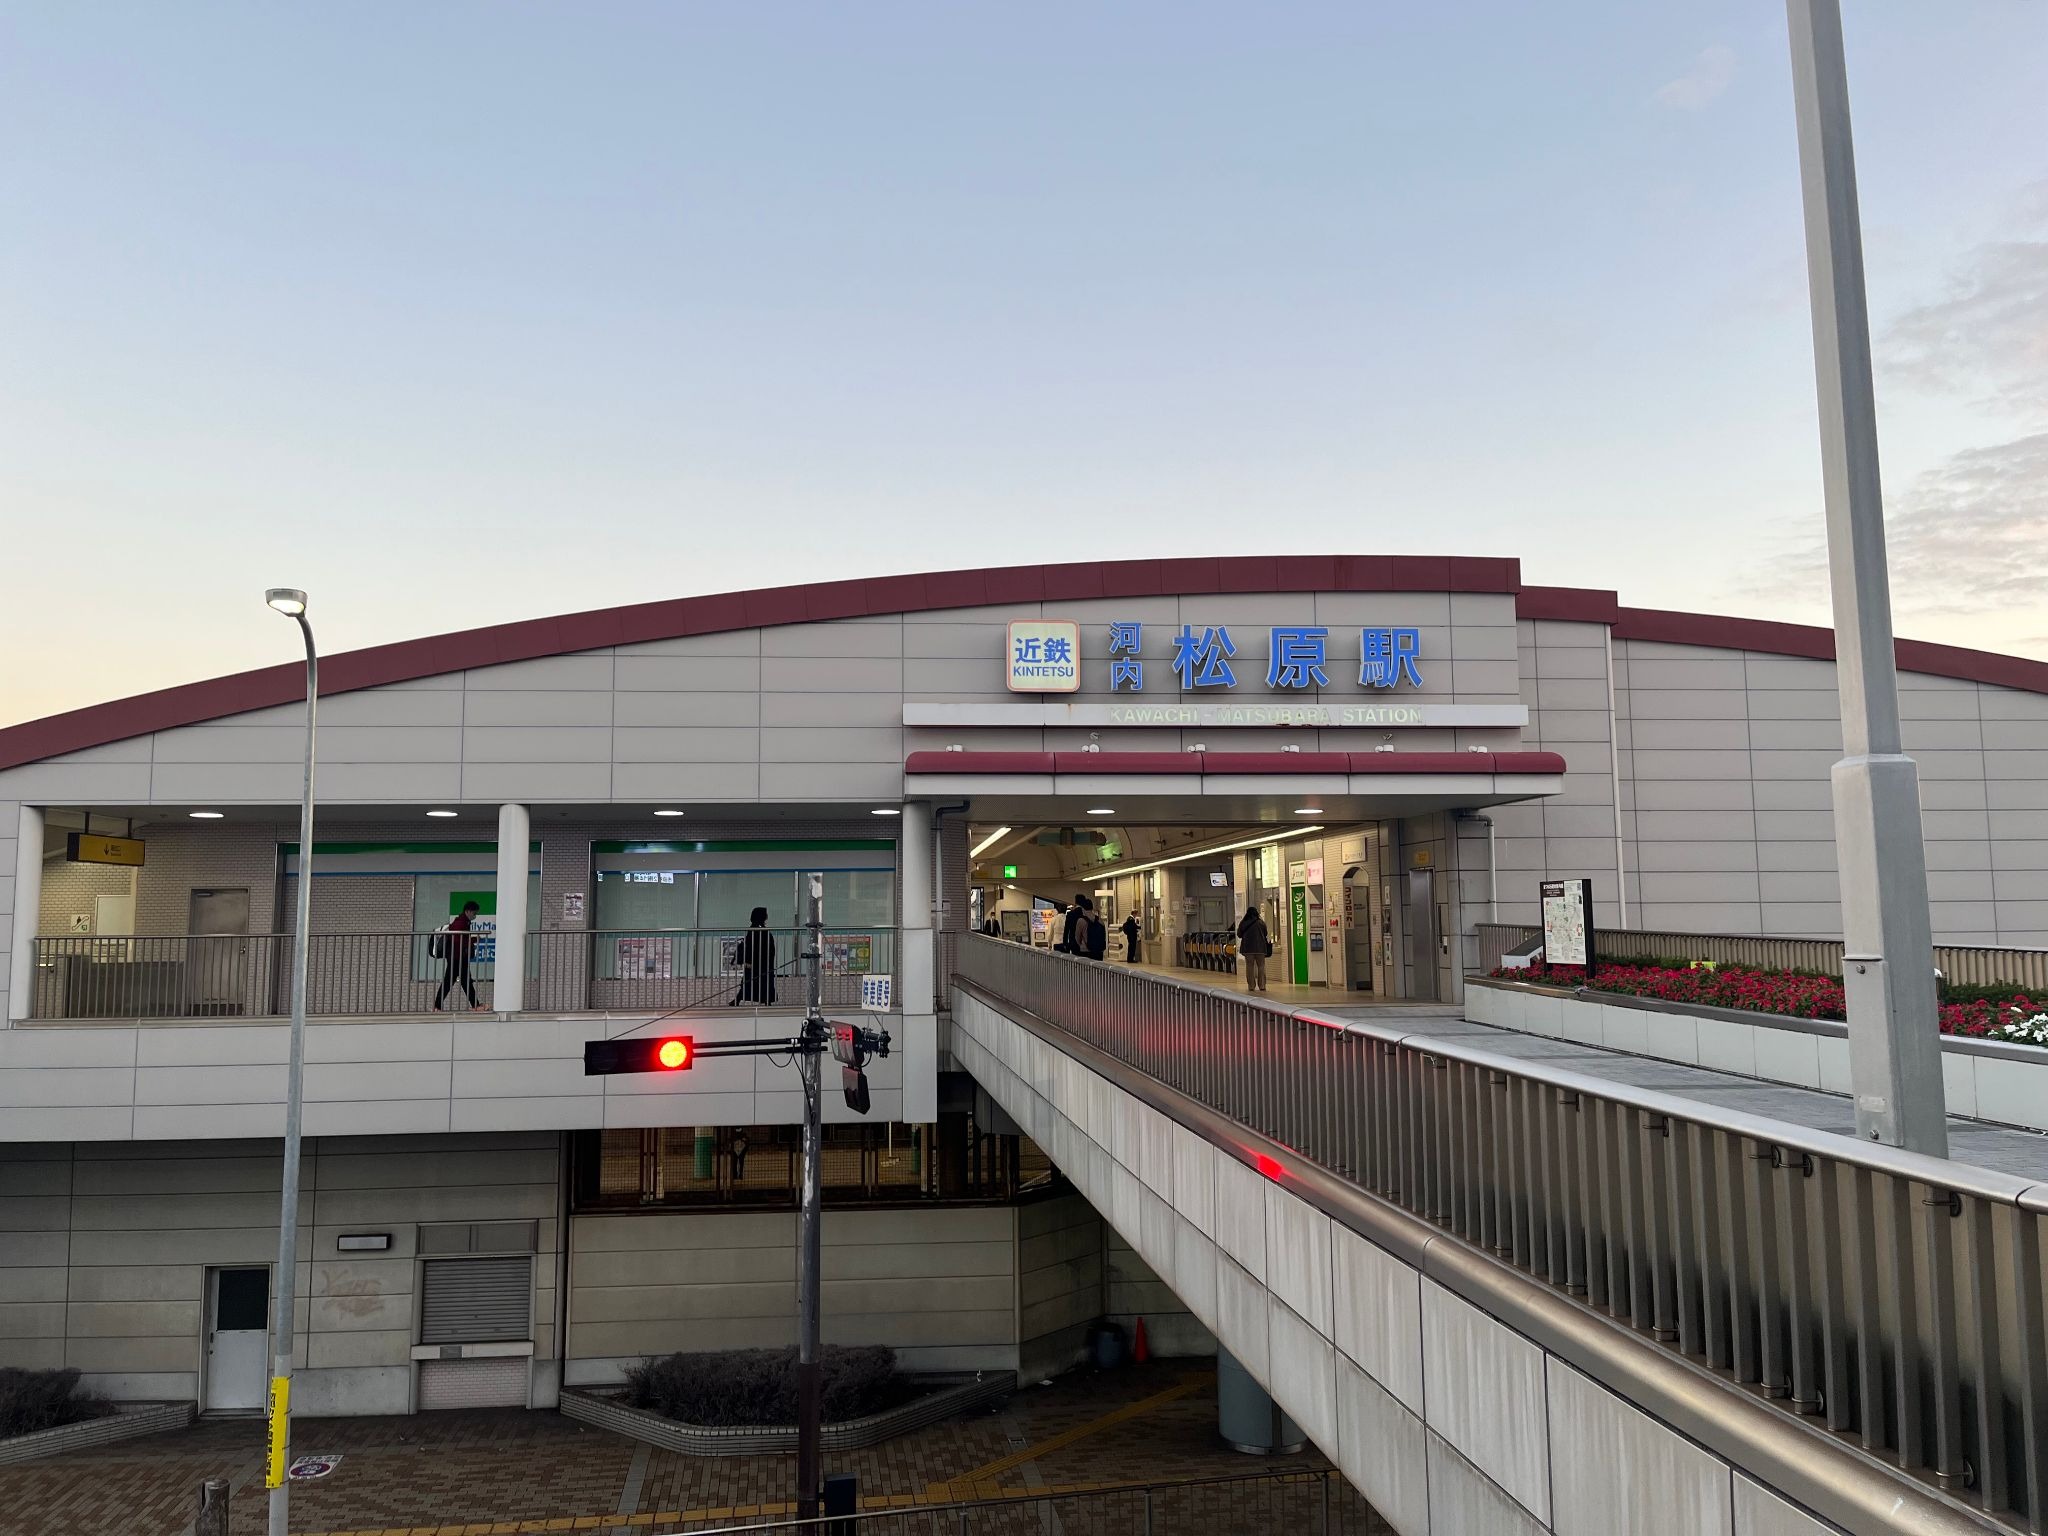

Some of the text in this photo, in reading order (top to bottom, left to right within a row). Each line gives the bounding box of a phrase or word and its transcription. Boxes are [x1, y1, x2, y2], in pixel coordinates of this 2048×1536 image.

[1014, 637, 1071, 664] 近鉄
[1109, 620, 1424, 692] 河内 松原駅
[1013, 666, 1074, 677] KINTETSU
[1343, 708, 1422, 723] STATION
[1344, 886, 1353, 928] コインロッカー
